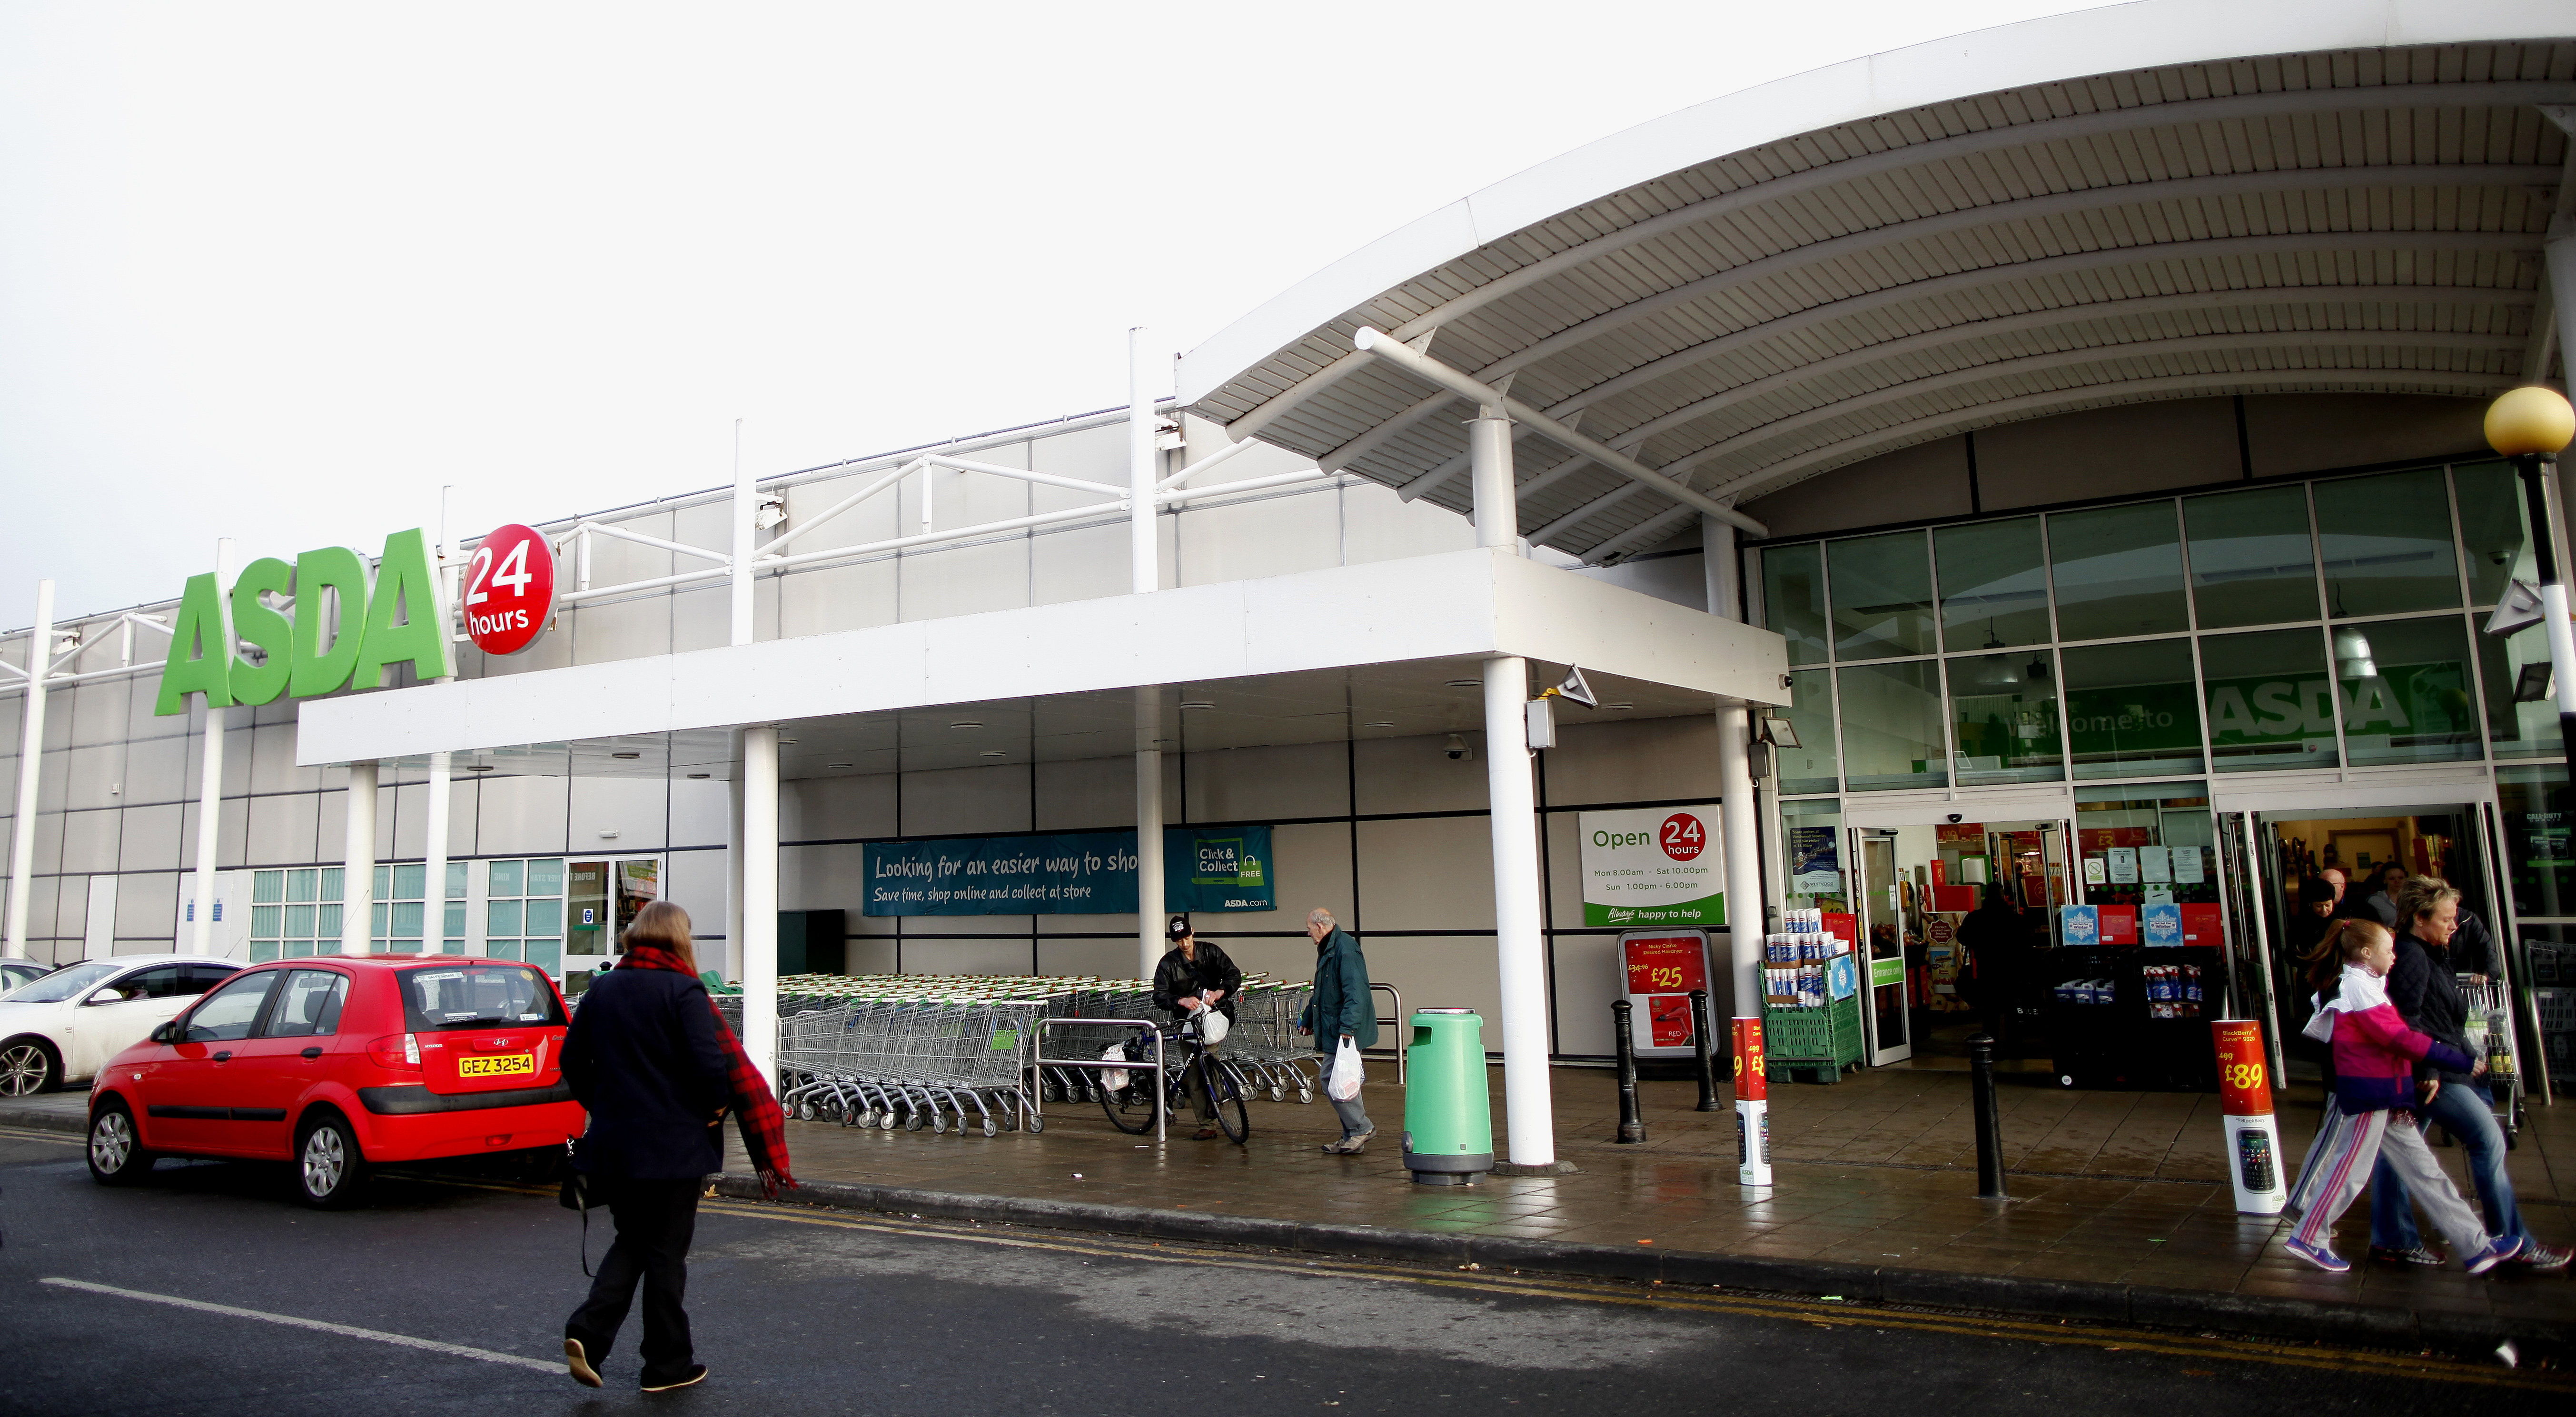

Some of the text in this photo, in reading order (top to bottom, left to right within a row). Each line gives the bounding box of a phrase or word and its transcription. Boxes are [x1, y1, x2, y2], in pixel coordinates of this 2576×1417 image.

[466, 539, 532, 605] 24
[155, 527, 448, 716] ASDA
[469, 609, 529, 635] hours
[2209, 674, 2410, 738] ASDA
[2144, 708, 2173, 728] to
[1593, 830, 1650, 849] Open
[1665, 820, 1700, 843] 24
[1199, 848, 1234, 859] Click &
[1668, 845, 1699, 854] hours
[876, 848, 1138, 882] Looking for an easier way to sho
[1199, 860, 1238, 872] Collect
[1672, 867, 1708, 875] 10.00pm
[873, 884, 1091, 904] Save time, shop online and collect at store
[1665, 882, 1698, 890] 6.00pm
[1224, 899, 1267, 907] ASDA.com
[1608, 908, 1635, 922] Always
[1638, 910, 1666, 920] happy
[1681, 909, 1701, 919] help
[1651, 967, 1683, 988] £25
[1874, 966, 1902, 978] Entrance only
[462, 1057, 530, 1074] GEZ 3254
[2219, 1052, 2233, 1061] £99
[2225, 1063, 2262, 1089] £89
